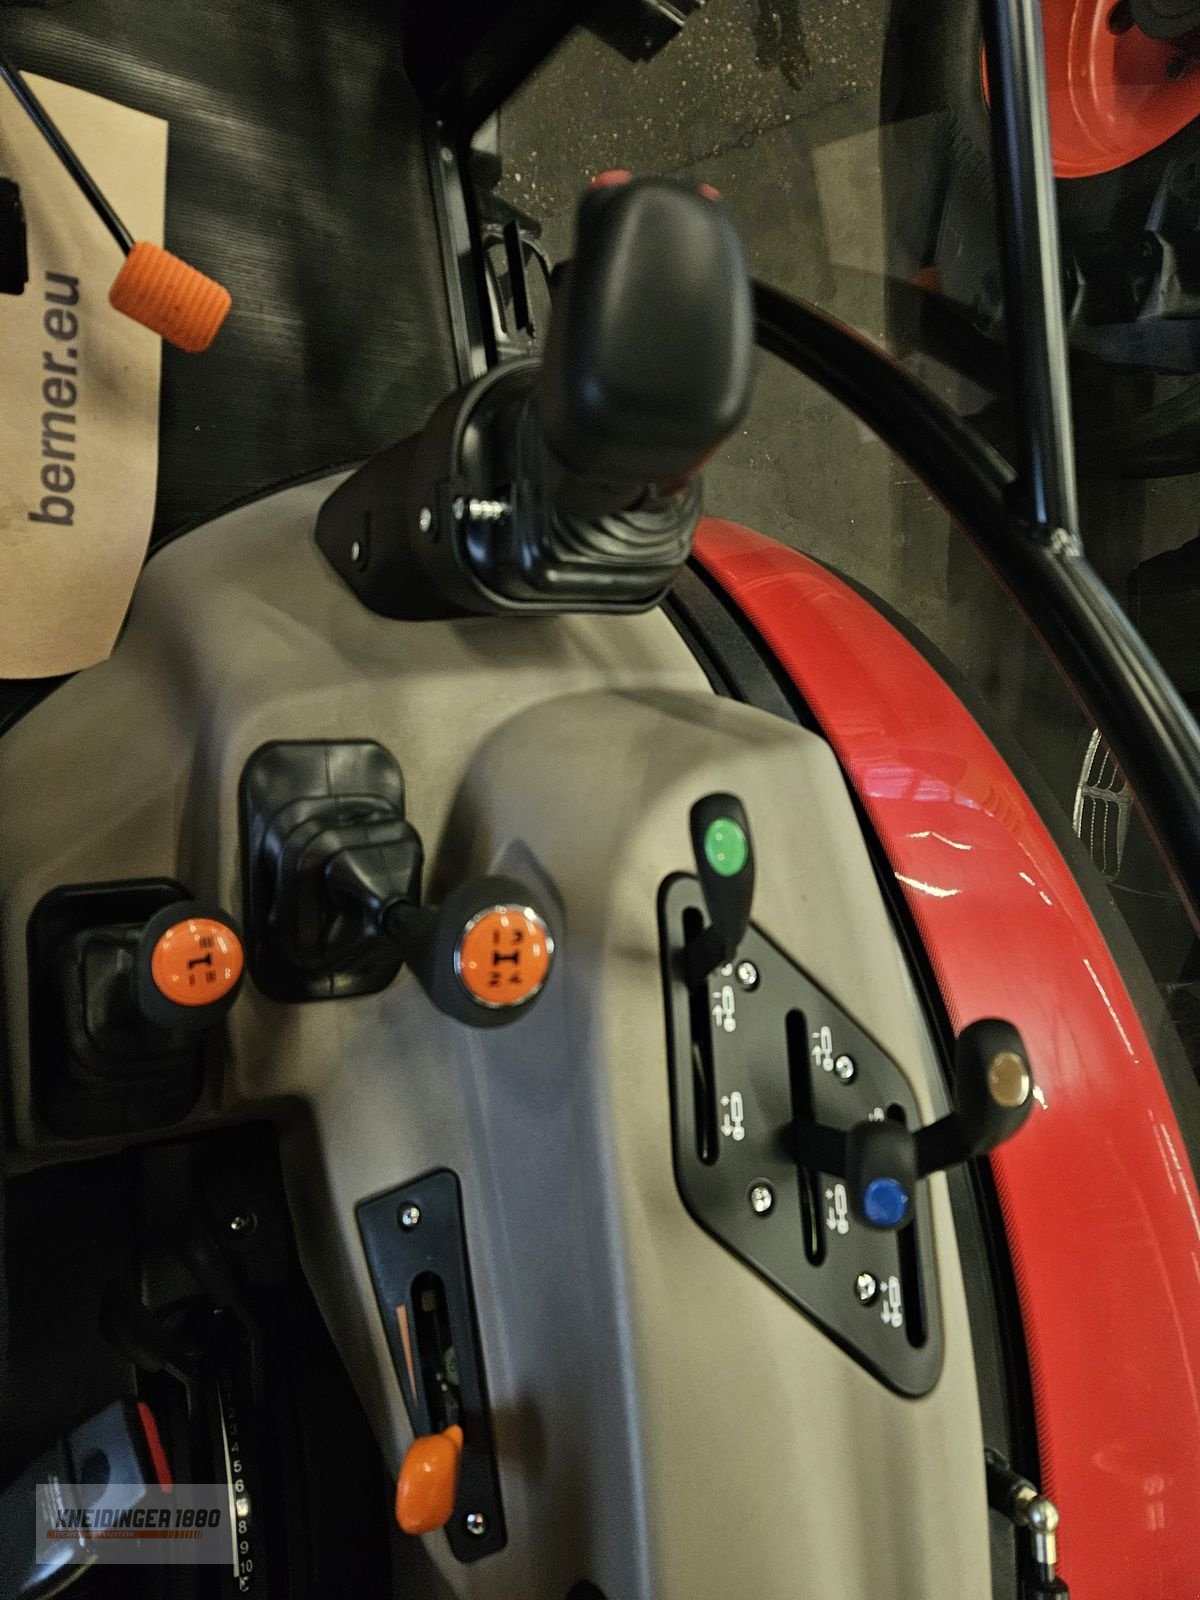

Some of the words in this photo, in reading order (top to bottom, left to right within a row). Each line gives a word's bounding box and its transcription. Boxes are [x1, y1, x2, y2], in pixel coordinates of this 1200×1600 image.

[28, 271, 80, 527] berner.eu
[233, 1460, 242, 1473] 5
[235, 1479, 244, 1493] 6
[238, 1520, 247, 1534] 8
[240, 1540, 249, 1554] 9
[241, 1559, 253, 1574] 10
